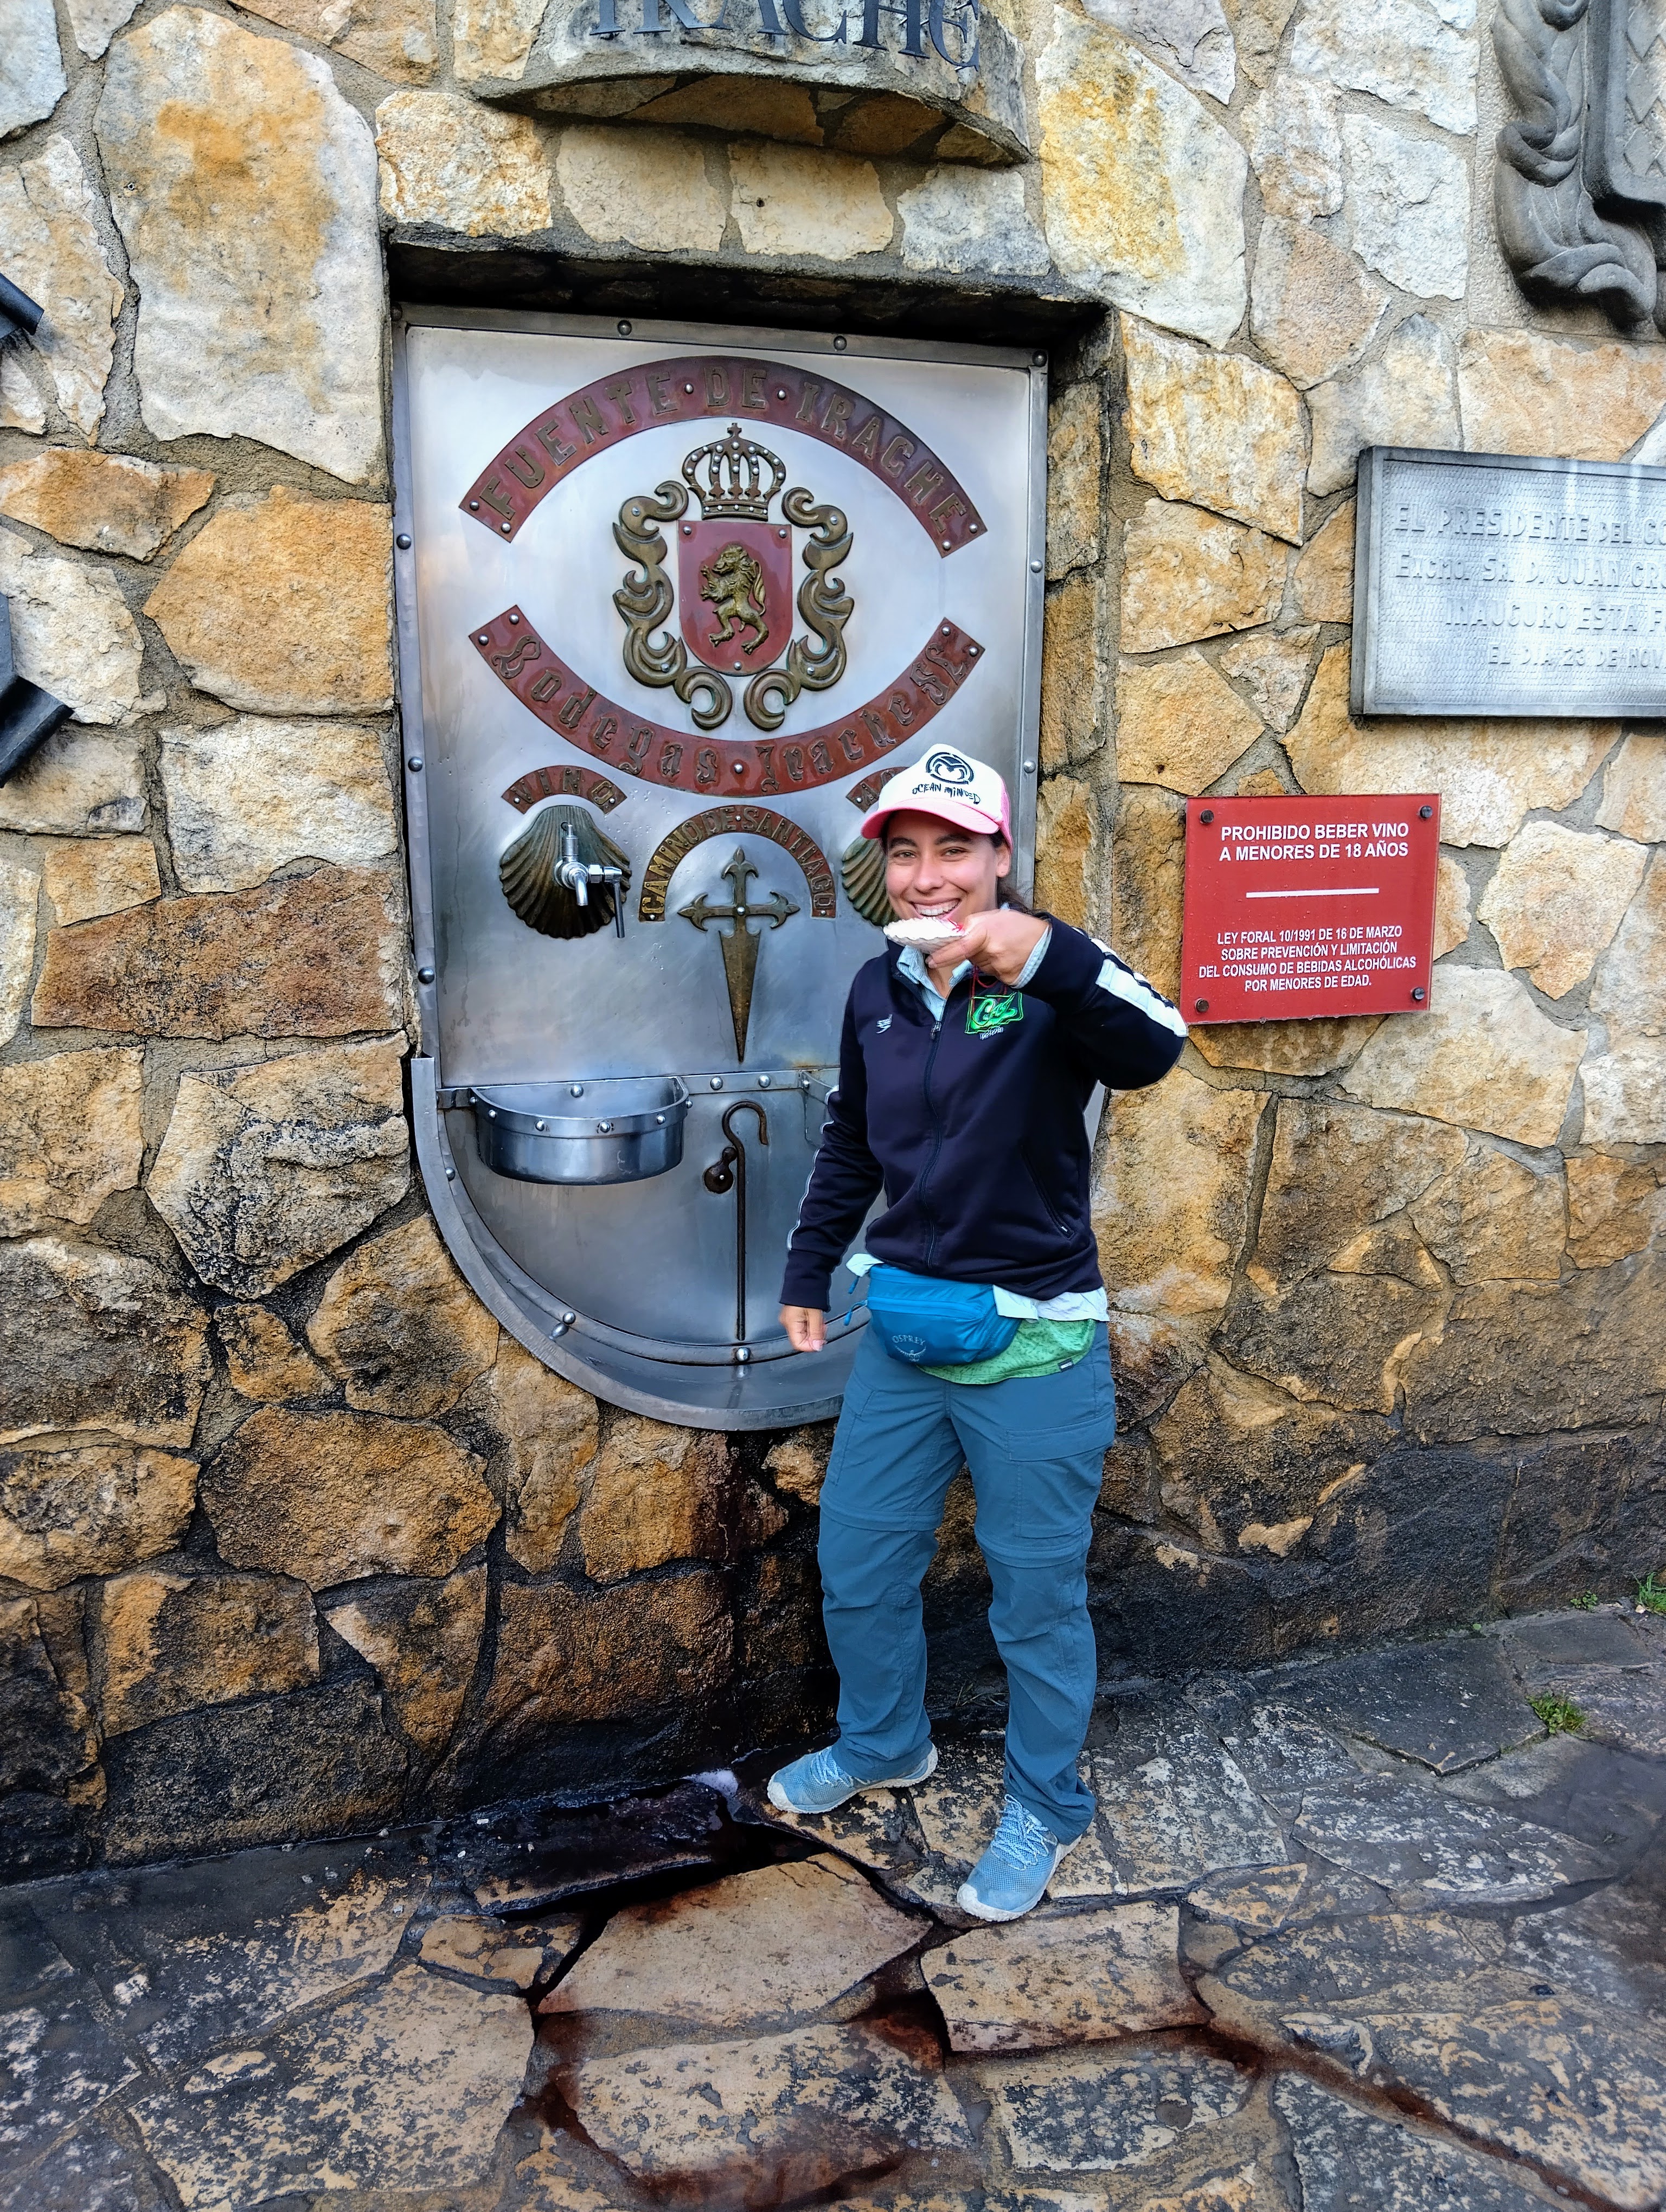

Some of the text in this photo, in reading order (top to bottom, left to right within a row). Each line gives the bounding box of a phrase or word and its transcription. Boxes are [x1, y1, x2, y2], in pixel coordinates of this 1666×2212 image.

[479, 366, 967, 534] FUENTE DE IRACHE
[1394, 503, 1425, 532] EL
[1437, 505, 1589, 541] PRESIDENTE
[1599, 522, 1632, 544] DEL
[1556, 558, 1620, 587] JUAN
[1578, 603, 1637, 632] ESTA
[1488, 644, 1510, 665] EL
[1597, 647, 1617, 668] DE
[491, 635, 719, 785] Bodegas
[755, 695, 916, 793] Irache
[510, 767, 616, 805] VINO
[912, 782, 941, 795] OCEAN
[1221, 822, 1409, 841] PROHIBIDO BEBER VINO
[641, 807, 836, 914] CAMINO DE SANTIAGO
[1219, 840, 1409, 861] A MENORES DE 18 AÑOS
[1217, 925, 1402, 945] LEY FORAL 10/1991 DE 16 DE MARZO
[1221, 939, 1398, 961] SOBRE PREVENCIÓN Y LIMITACIÓN
[1199, 955, 1417, 979] DEL CONSUMO DE BEBIDAS ALCOHÓLICAS
[1244, 974, 1372, 992] POR MENORES DE EDAD.
[891, 1334, 926, 1346] OSPREY
